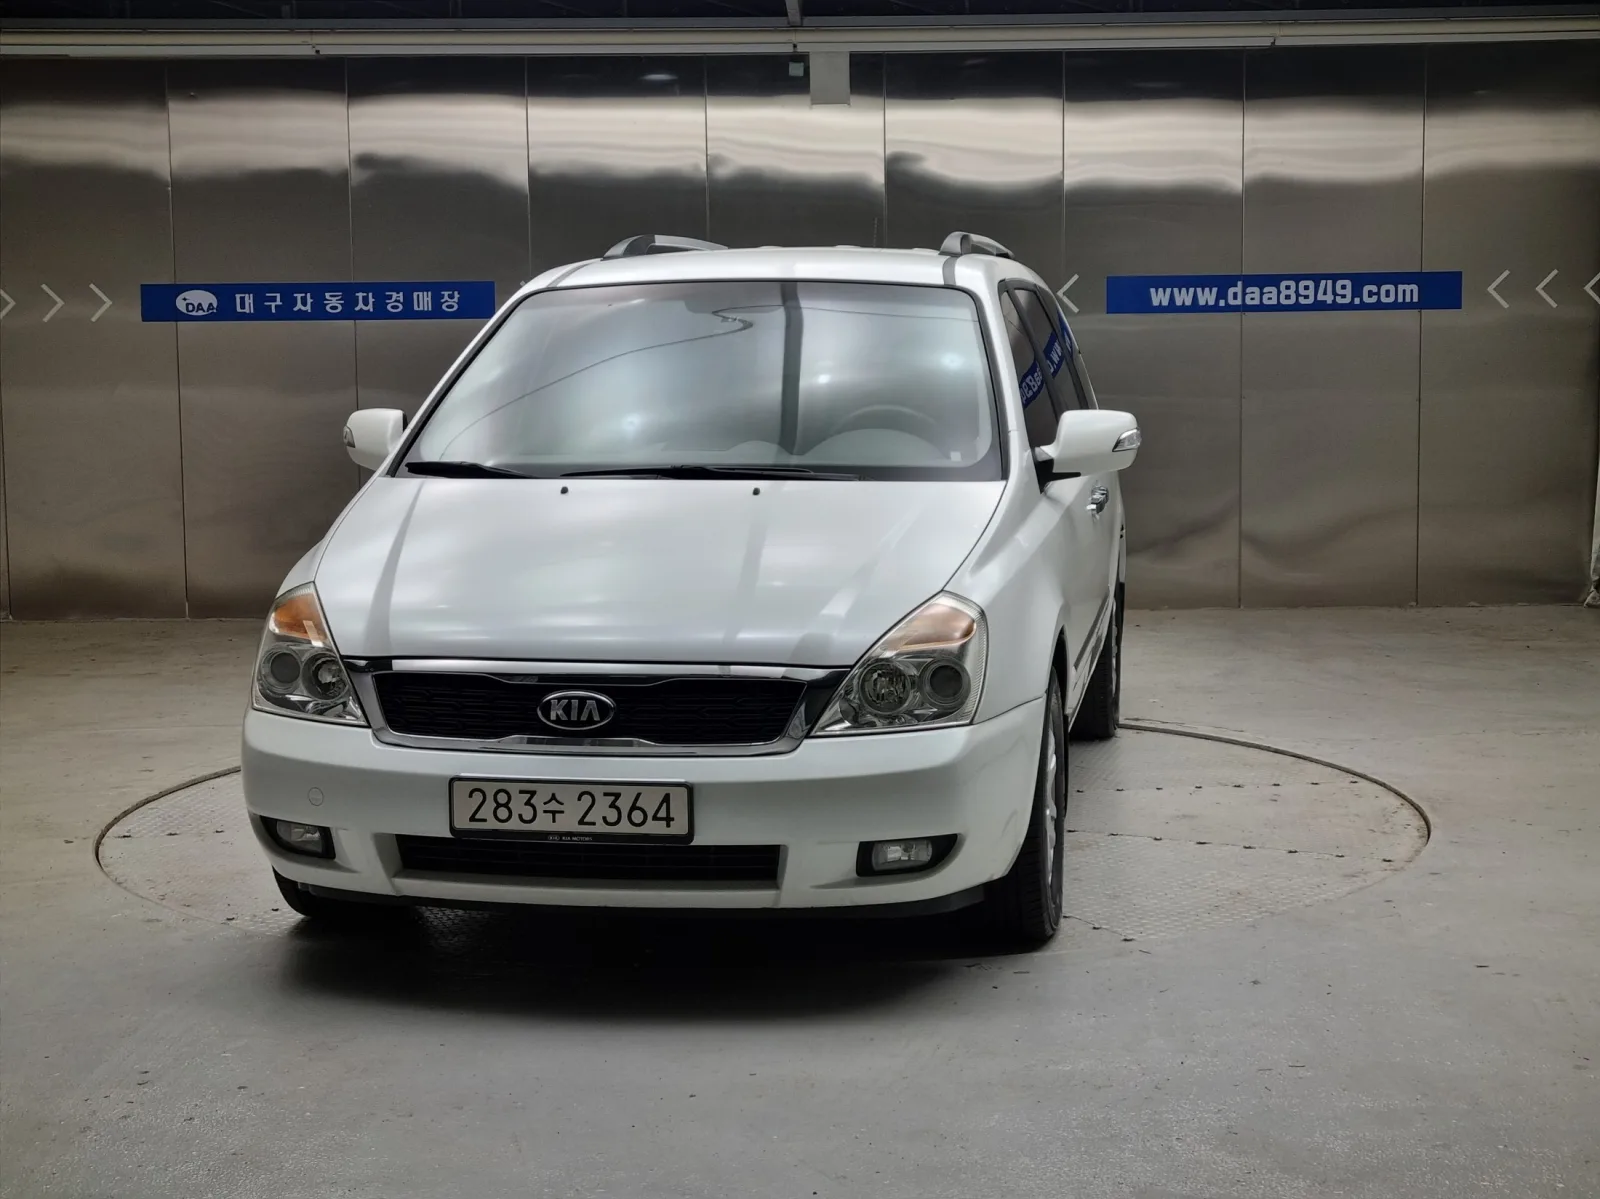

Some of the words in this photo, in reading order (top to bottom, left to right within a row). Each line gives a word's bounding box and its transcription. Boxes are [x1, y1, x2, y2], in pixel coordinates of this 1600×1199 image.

[1150, 279, 1420, 307] www.daa8949.com
[185, 302, 217, 313] DAA
[550, 699, 601, 721] KIA
